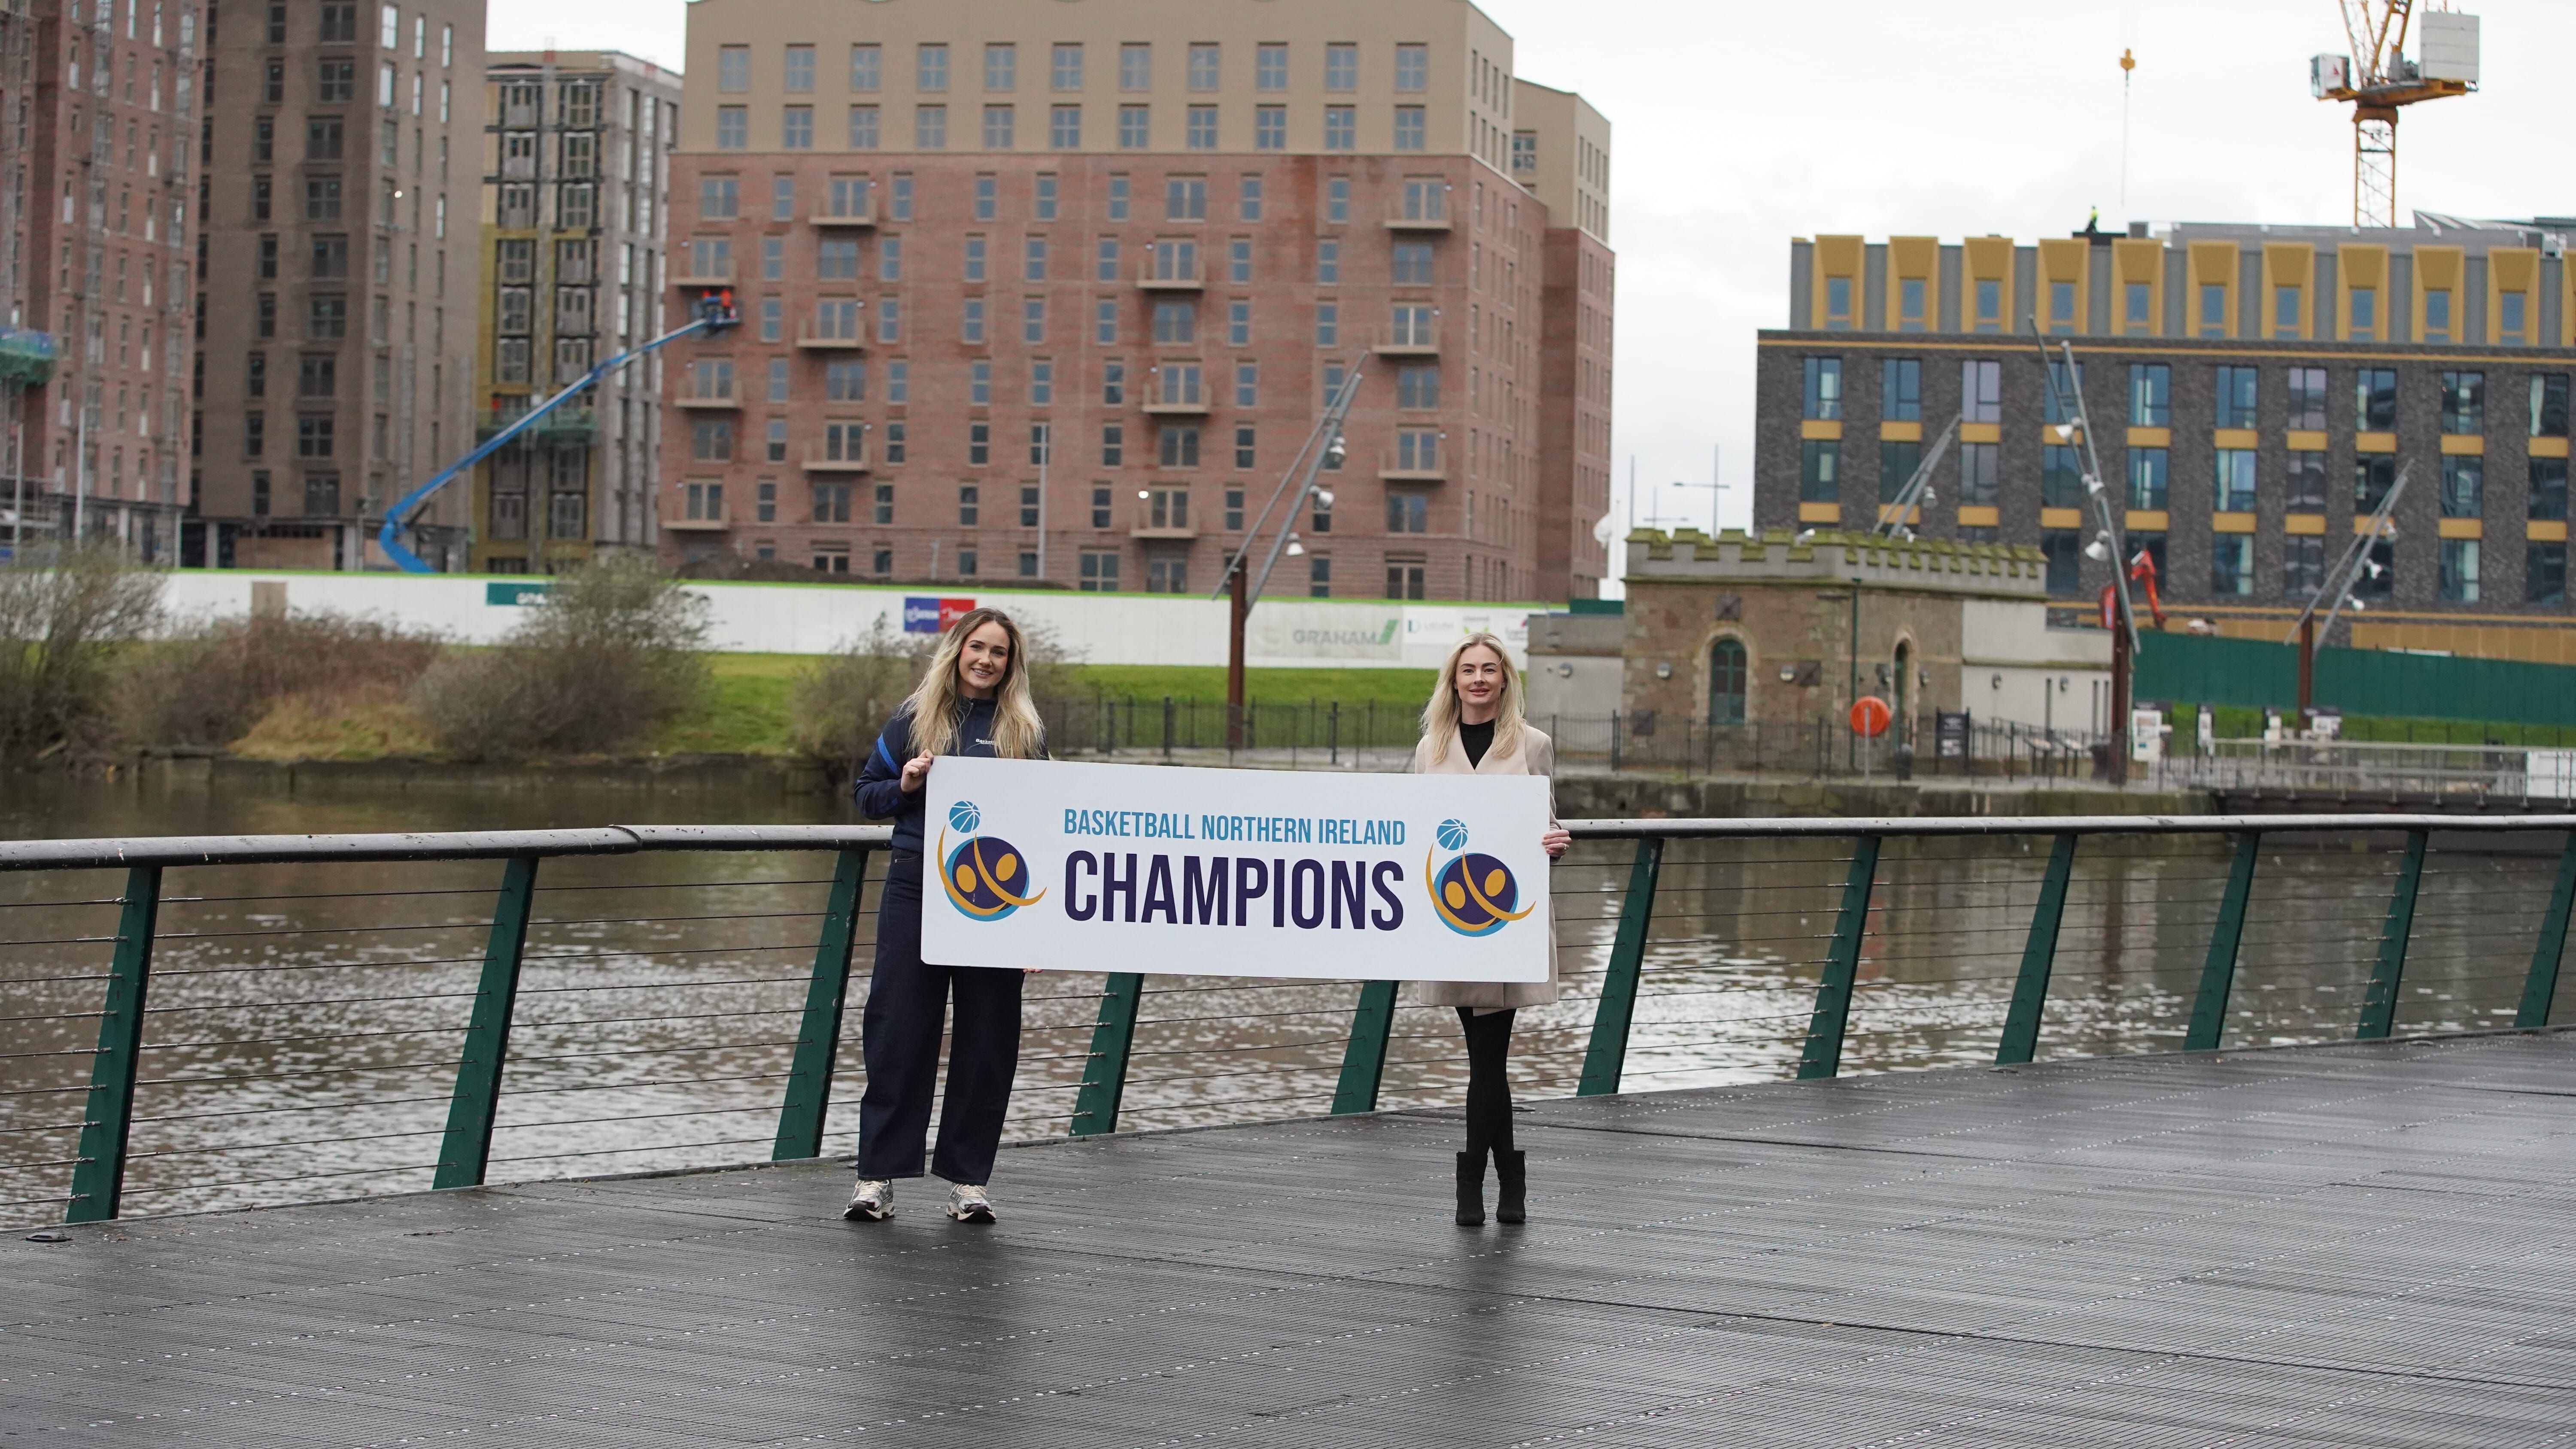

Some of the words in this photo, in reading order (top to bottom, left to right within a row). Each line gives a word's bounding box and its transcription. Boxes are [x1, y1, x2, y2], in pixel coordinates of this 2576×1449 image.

[1292, 629, 1377, 645] GRAHAM
[1064, 809, 1196, 839] BASKETBALL
[1202, 815, 1311, 843] NORTHERN
[1318, 819, 1405, 845] IRELAND
[1064, 850, 1404, 931] CHAMPIONS
